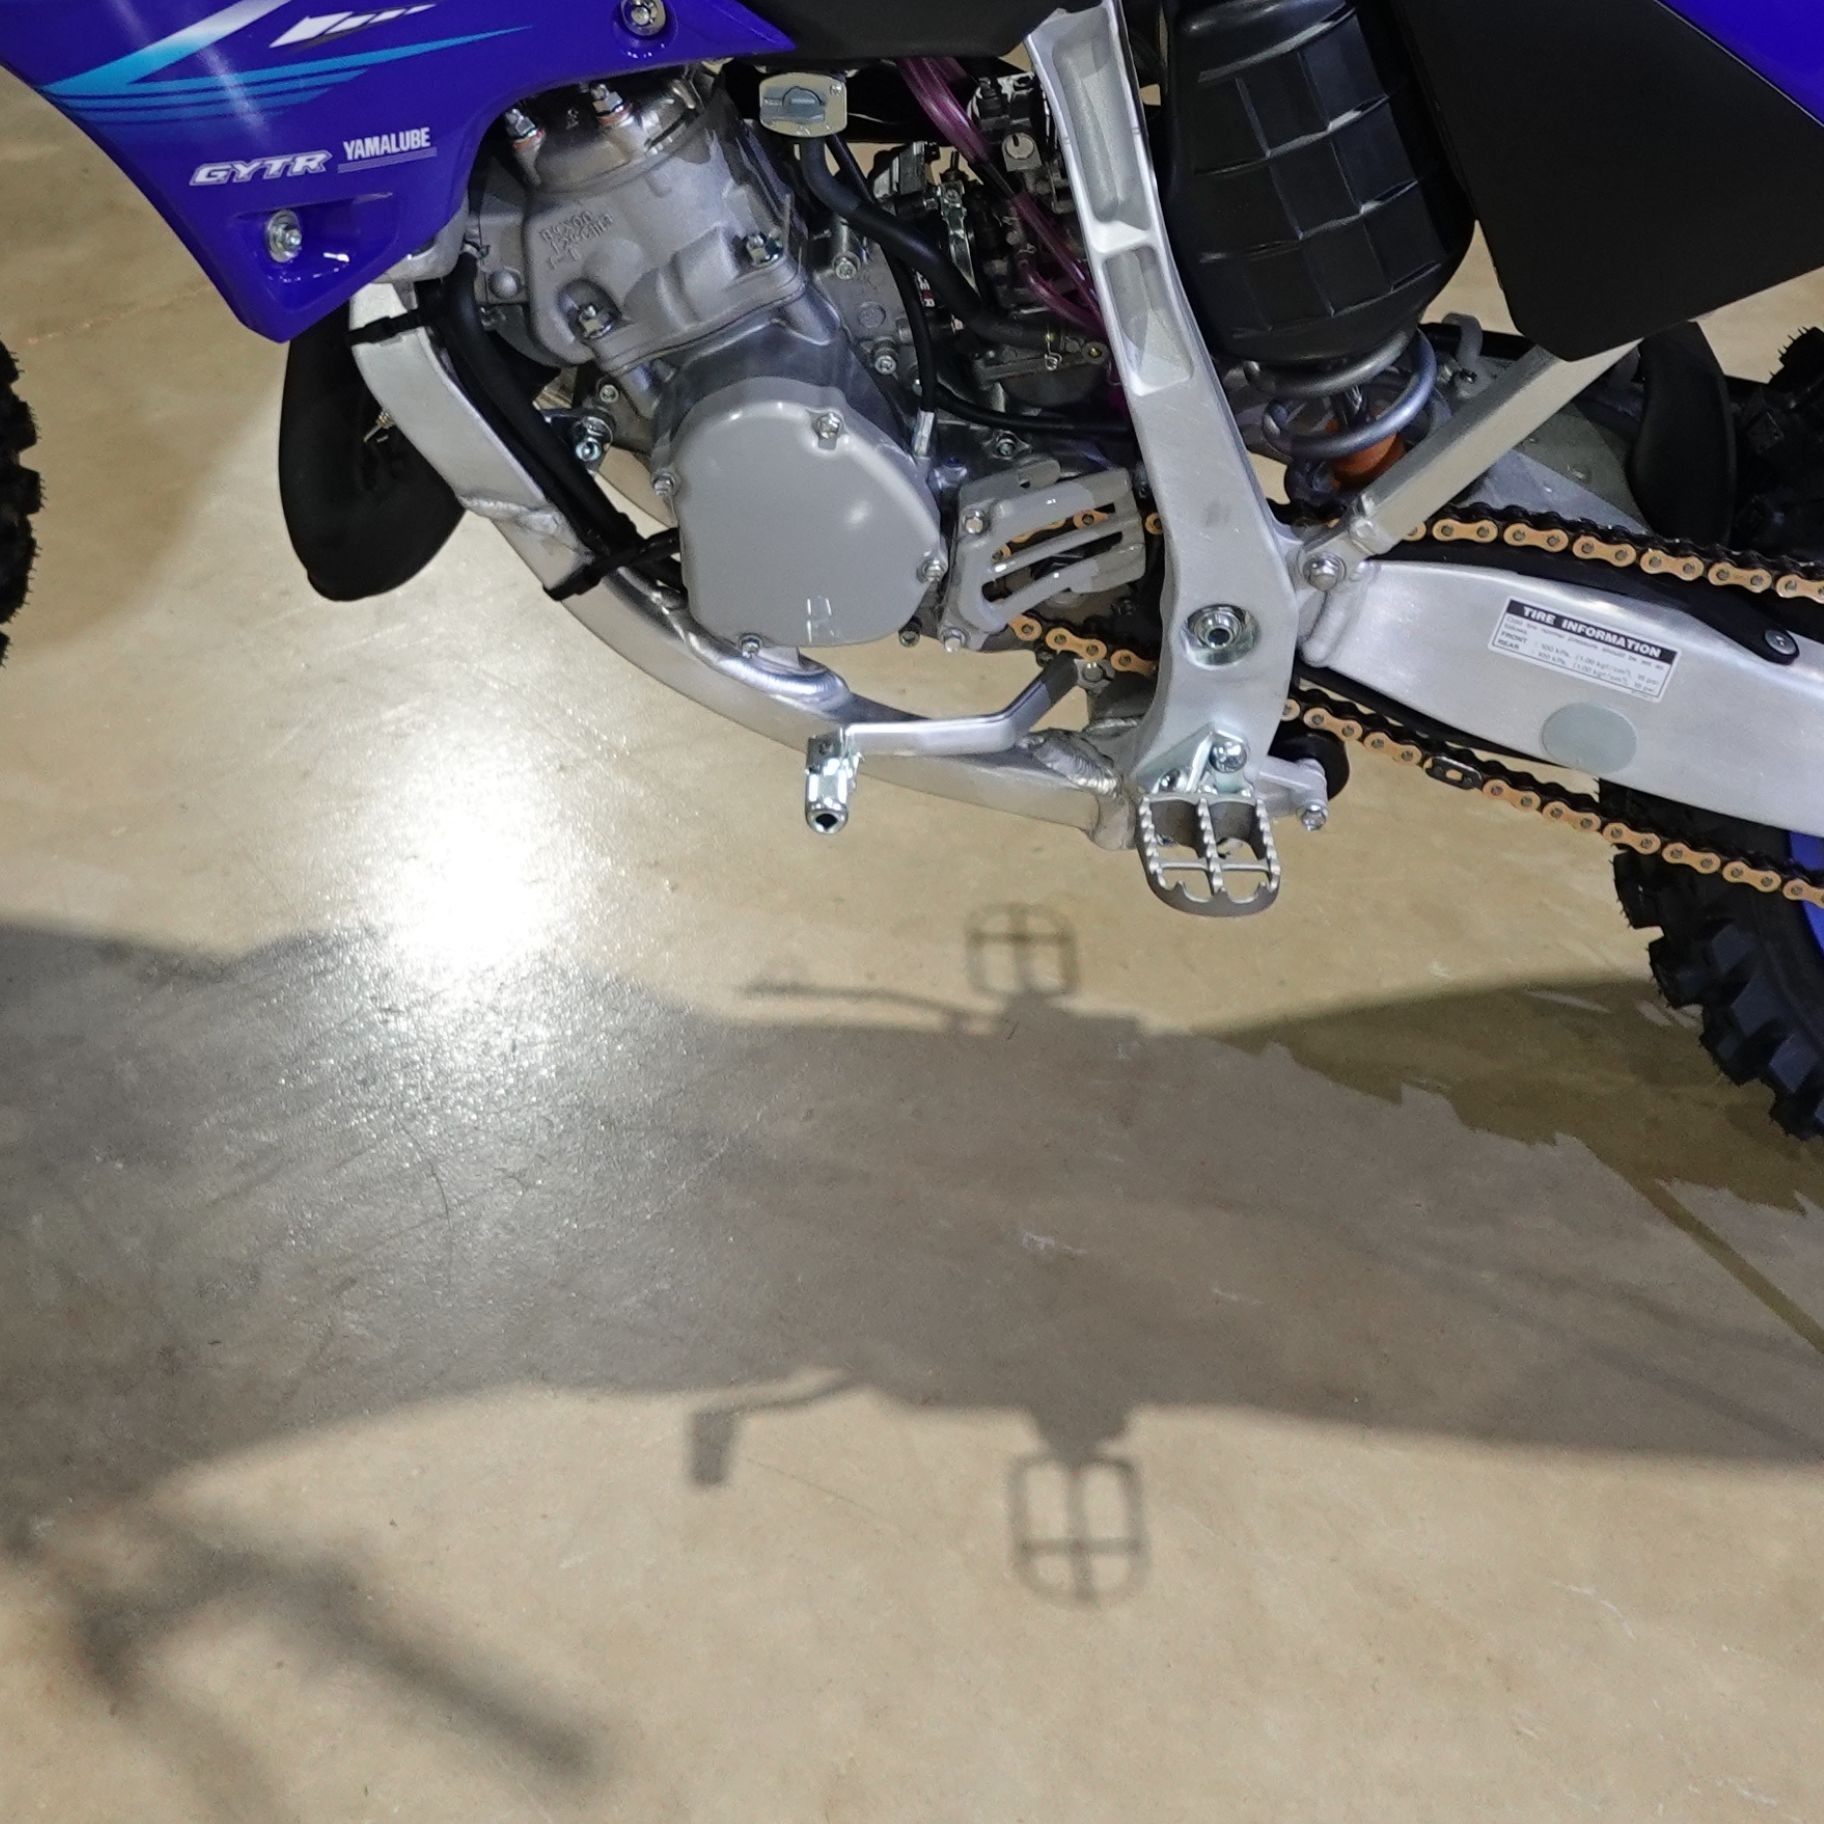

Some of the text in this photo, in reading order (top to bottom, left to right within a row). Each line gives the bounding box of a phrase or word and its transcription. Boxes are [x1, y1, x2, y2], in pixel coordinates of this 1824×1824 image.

[190, 127, 432, 186] GYTR YAMALUBE
[1498, 638, 1520, 651] REAR
[1501, 630, 1528, 645] FRONT
[1523, 606, 1662, 658] TIRE INFORMATION
